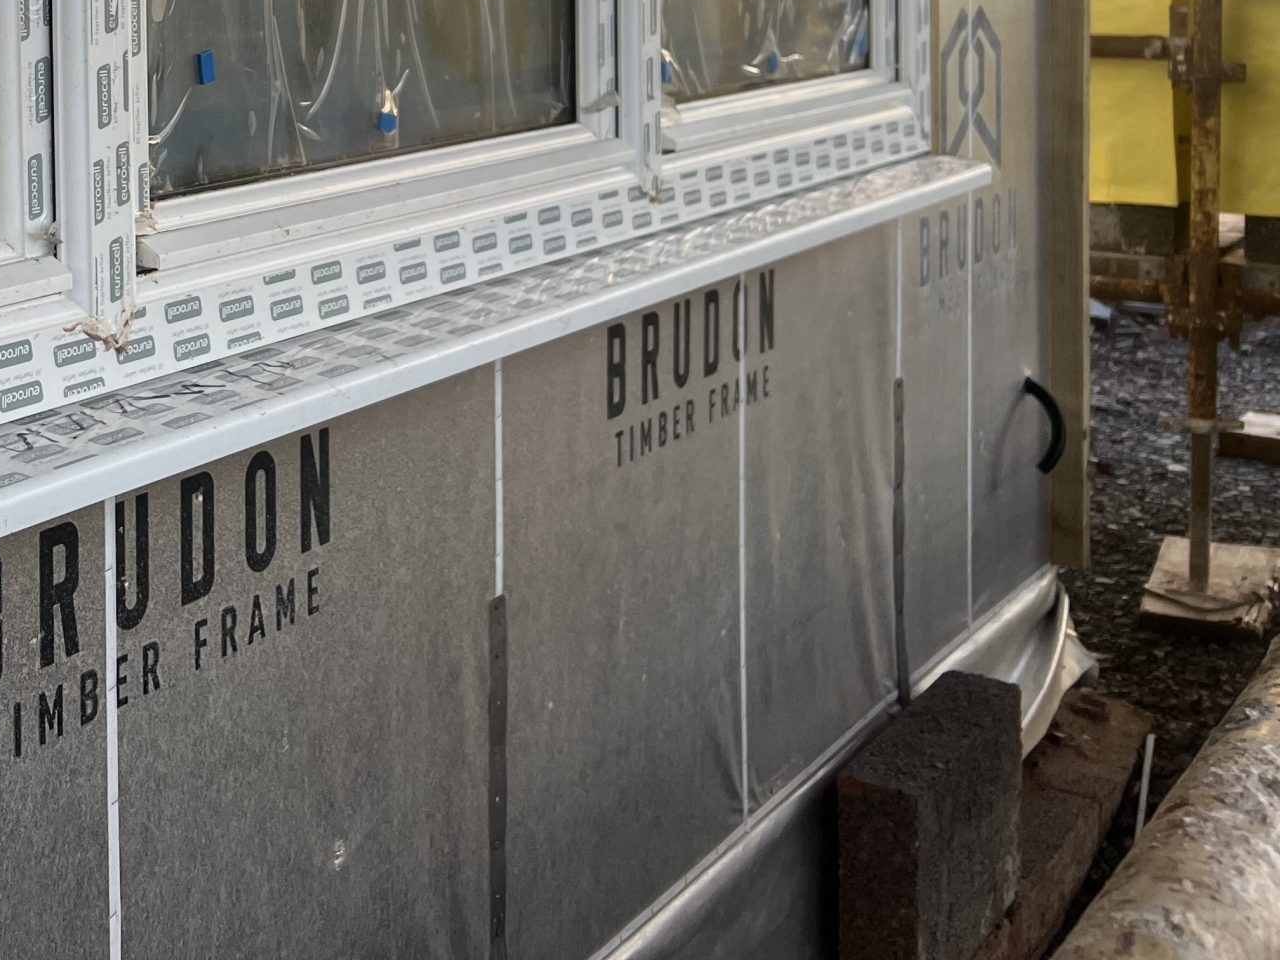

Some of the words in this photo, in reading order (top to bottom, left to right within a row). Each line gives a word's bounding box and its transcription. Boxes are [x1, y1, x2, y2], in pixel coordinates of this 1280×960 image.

[131, 0, 139, 53] eurocell
[38, 62, 48, 119] eurocell
[99, 69, 109, 124] eurocell
[31, 159, 41, 215] eurocell
[93, 166, 102, 220] eurocell
[118, 146, 128, 201] eurocell
[920, 187, 1017, 288] BRUDON
[111, 242, 121, 297] eurocell
[168, 301, 200, 320] eurocell
[222, 300, 252, 318] eurocell
[177, 338, 208, 357] eurocell
[607, 268, 775, 421] BRUDON
[2, 385, 40, 409] eurocell
[615, 398, 695, 468] TIMBER
[708, 365, 770, 424] FRAME
[194, 566, 320, 671] FRAME
